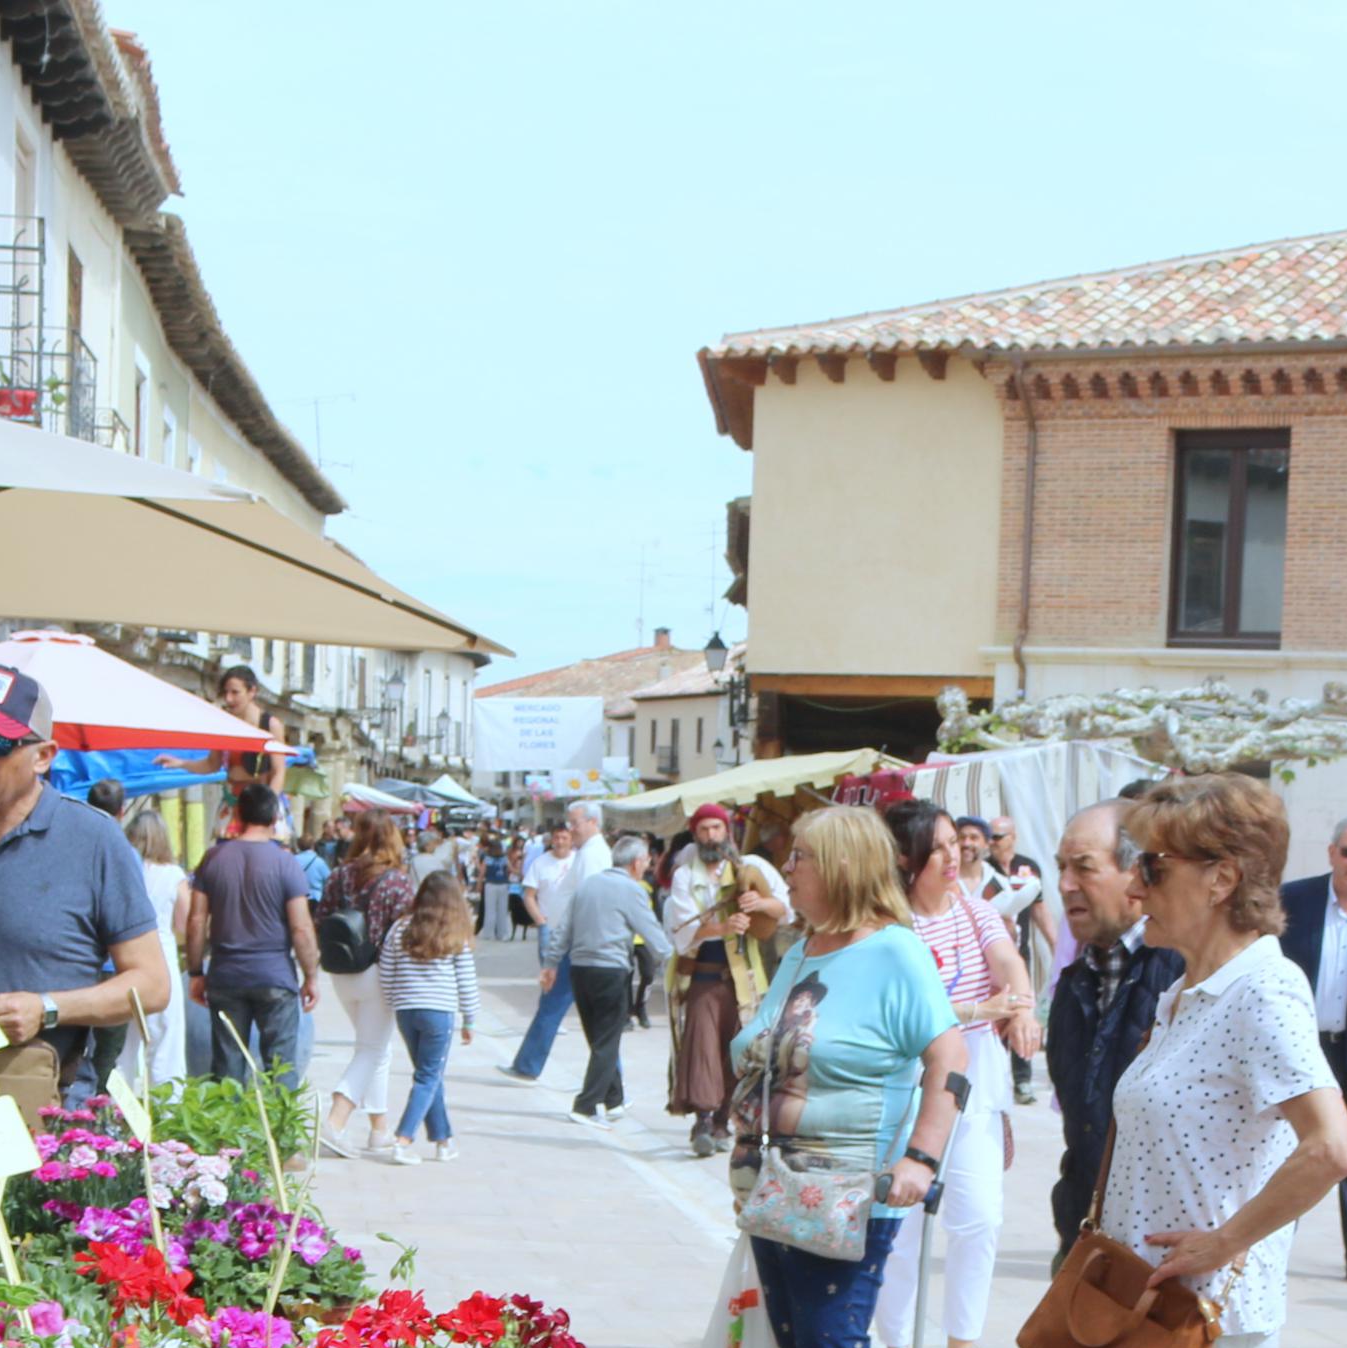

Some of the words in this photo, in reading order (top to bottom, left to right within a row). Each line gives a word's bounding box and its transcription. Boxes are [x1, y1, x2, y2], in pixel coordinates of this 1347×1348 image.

[513, 704, 561, 712] MERCADO
[519, 729, 532, 737] DE
[534, 729, 553, 737] LAS
[518, 741, 556, 749] FLORES
